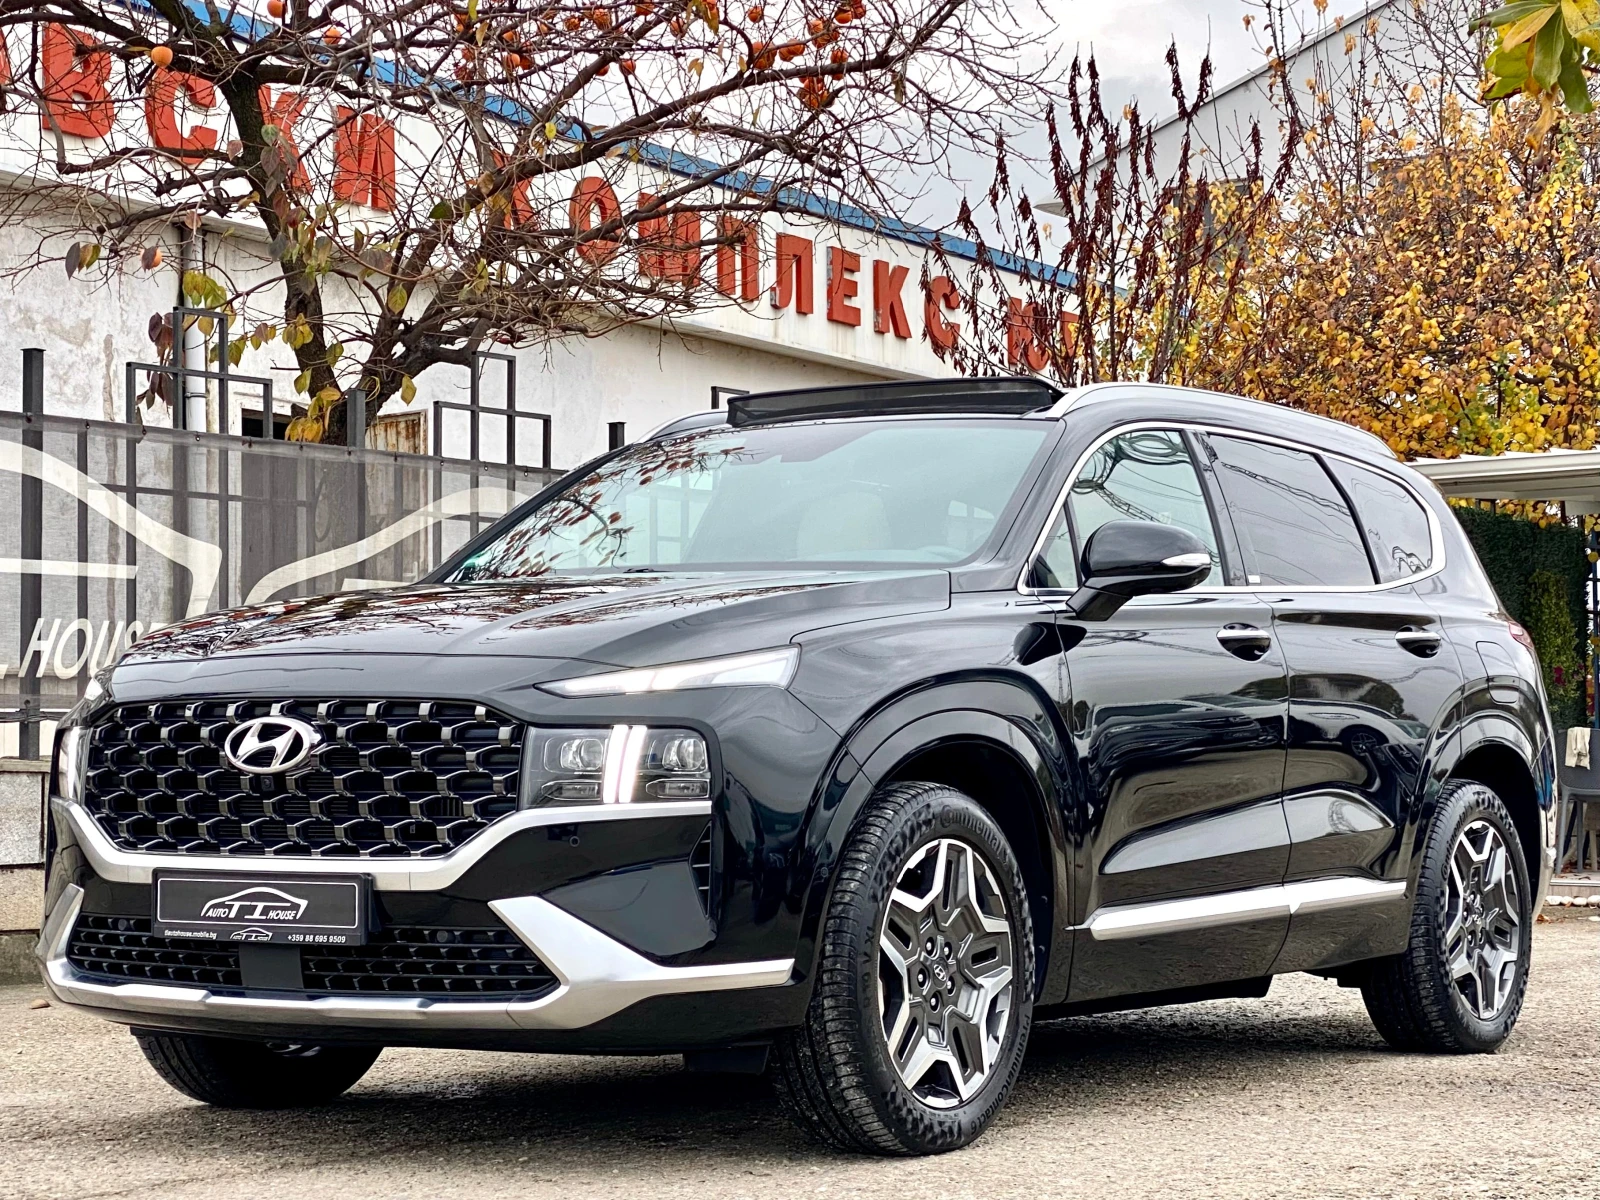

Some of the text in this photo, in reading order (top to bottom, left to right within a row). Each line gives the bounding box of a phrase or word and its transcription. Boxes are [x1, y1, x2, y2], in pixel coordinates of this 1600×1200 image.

[0, 22, 396, 213] ВСКИ
[18, 617, 168, 680] HOU
[206, 908, 229, 918] AUTO
[267, 910, 296, 920] HOUSE
[287, 934, 346, 943] +359 88 695 9509
